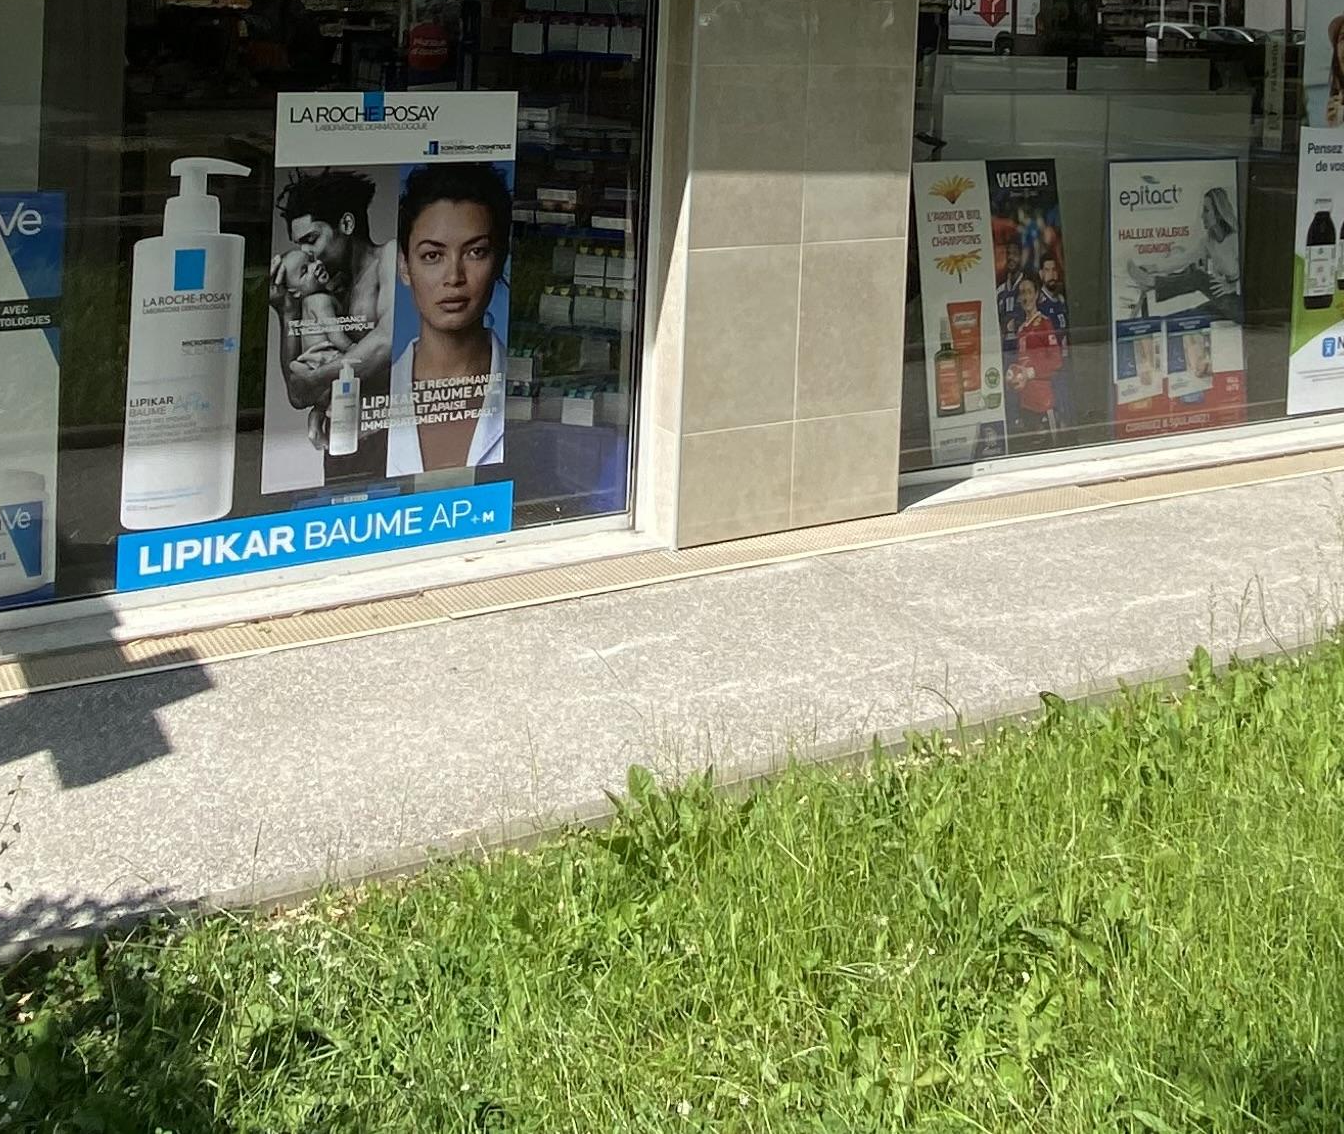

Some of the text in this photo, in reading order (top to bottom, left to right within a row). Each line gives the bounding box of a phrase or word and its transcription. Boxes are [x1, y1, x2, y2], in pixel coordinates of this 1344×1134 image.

[290, 106, 313, 123] LA
[1307, 142, 1343, 154] Pensez
[1315, 160, 1328, 172] de
[996, 170, 1049, 188] WELEDA
[143, 297, 157, 308] LA
[2, 304, 29, 316] AVEC
[423, 386, 473, 403] BAUME
[130, 396, 174, 408] LIPIKAR
[417, 404, 429, 415] ET
[430, 401, 466, 413] APAISE
[450, 412, 463, 422] LA
[139, 525, 295, 576] LIPIKAR
[305, 506, 424, 551] BAUME
